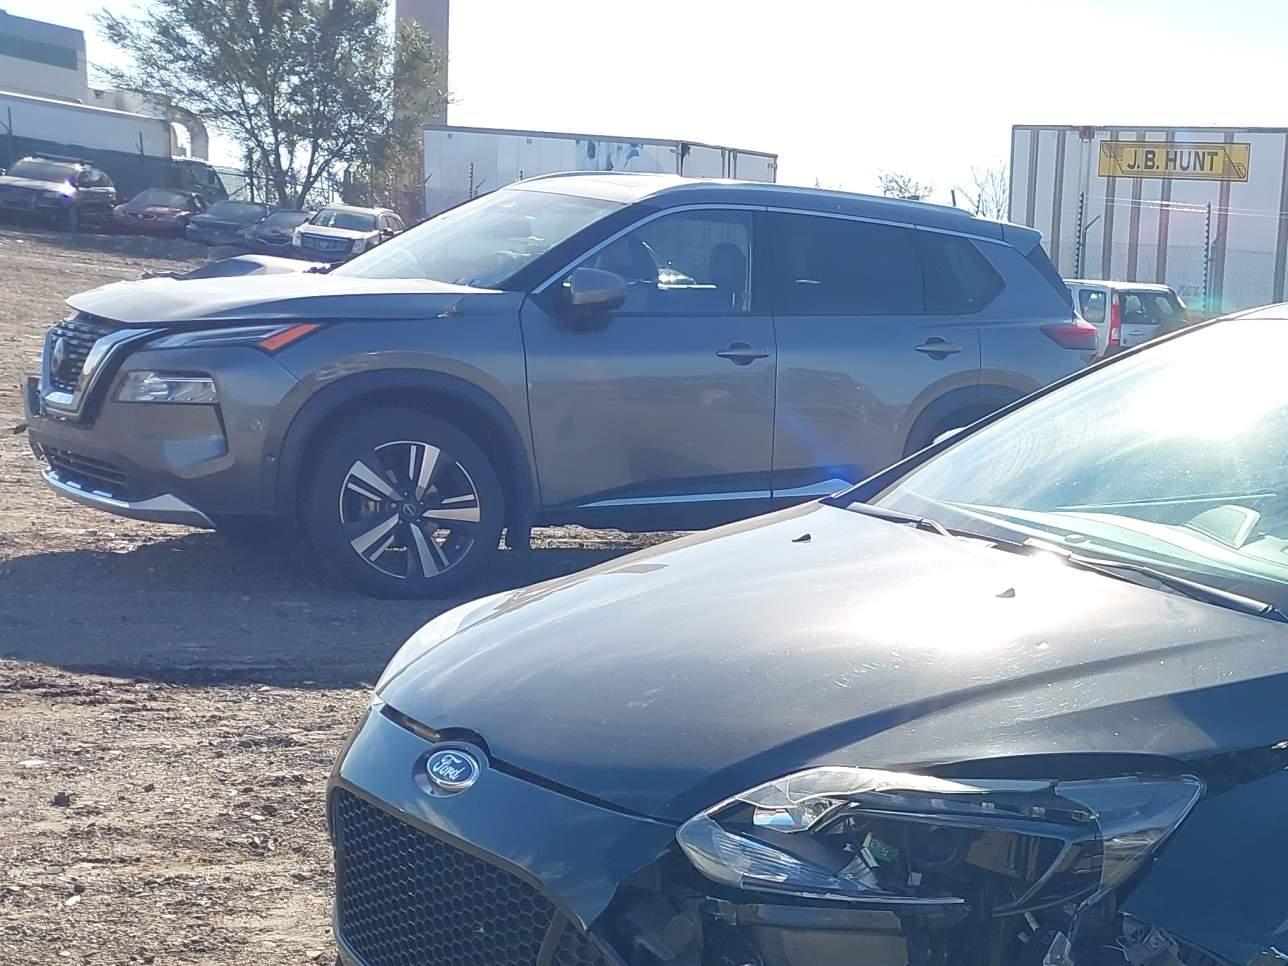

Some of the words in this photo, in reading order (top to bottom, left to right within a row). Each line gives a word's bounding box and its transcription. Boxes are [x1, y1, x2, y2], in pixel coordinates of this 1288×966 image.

[1127, 149, 1160, 170] J.B.
[1164, 149, 1219, 172] HUNT
[432, 754, 466, 780] Ford
